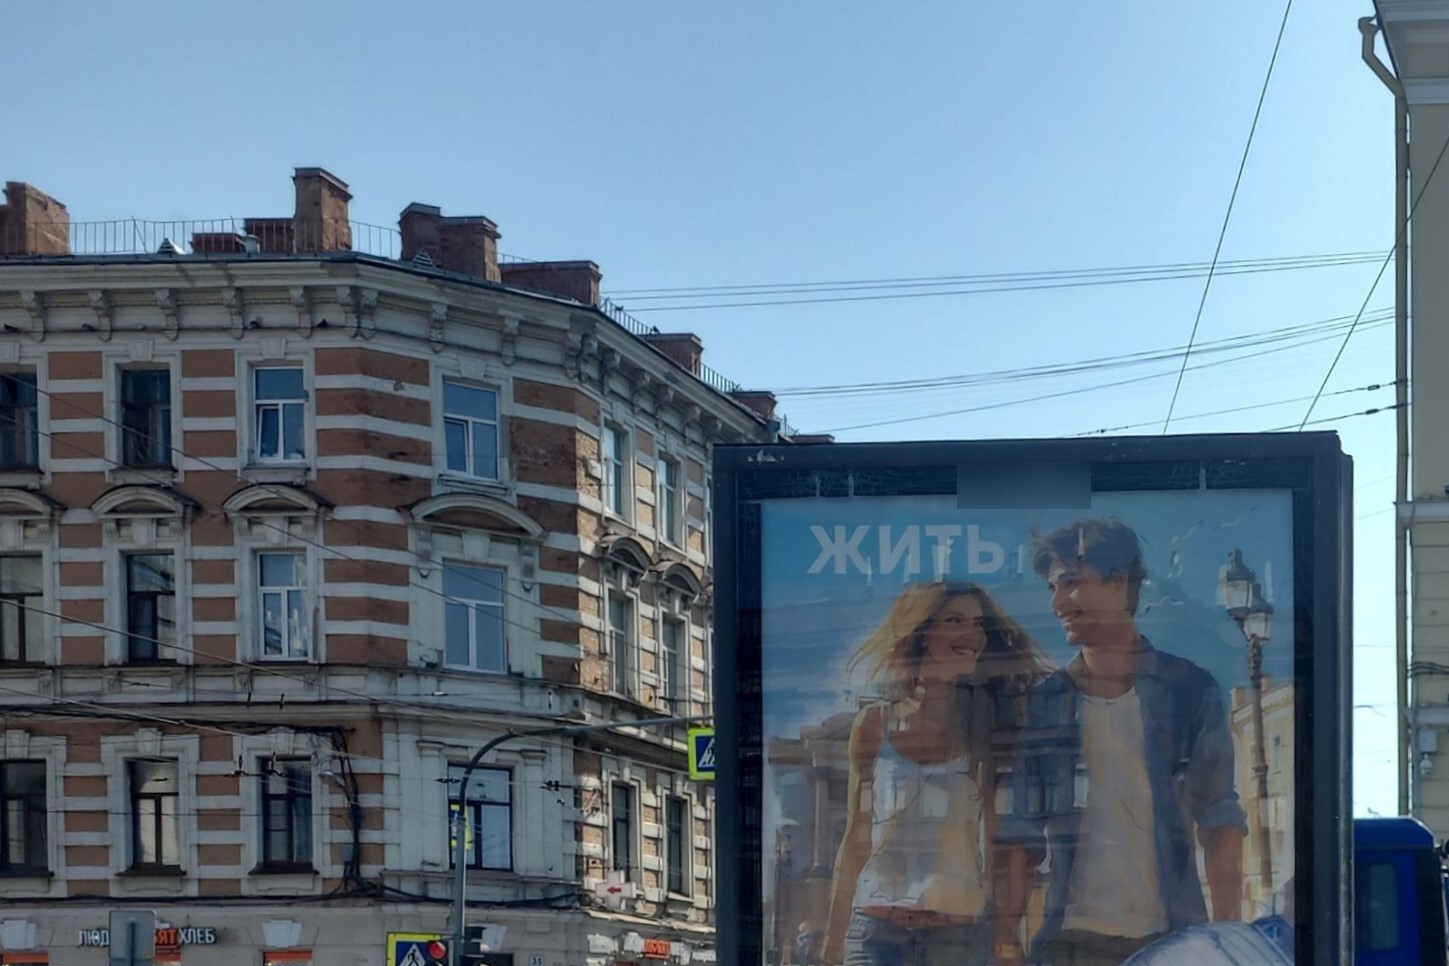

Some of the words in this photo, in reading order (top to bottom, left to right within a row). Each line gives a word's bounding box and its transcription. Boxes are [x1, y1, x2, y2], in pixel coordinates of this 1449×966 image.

[807, 523, 1006, 575] ЖИТЬ
[79, 929, 109, 946] ЛЮД
[179, 928, 216, 943] ХЛЕБ
